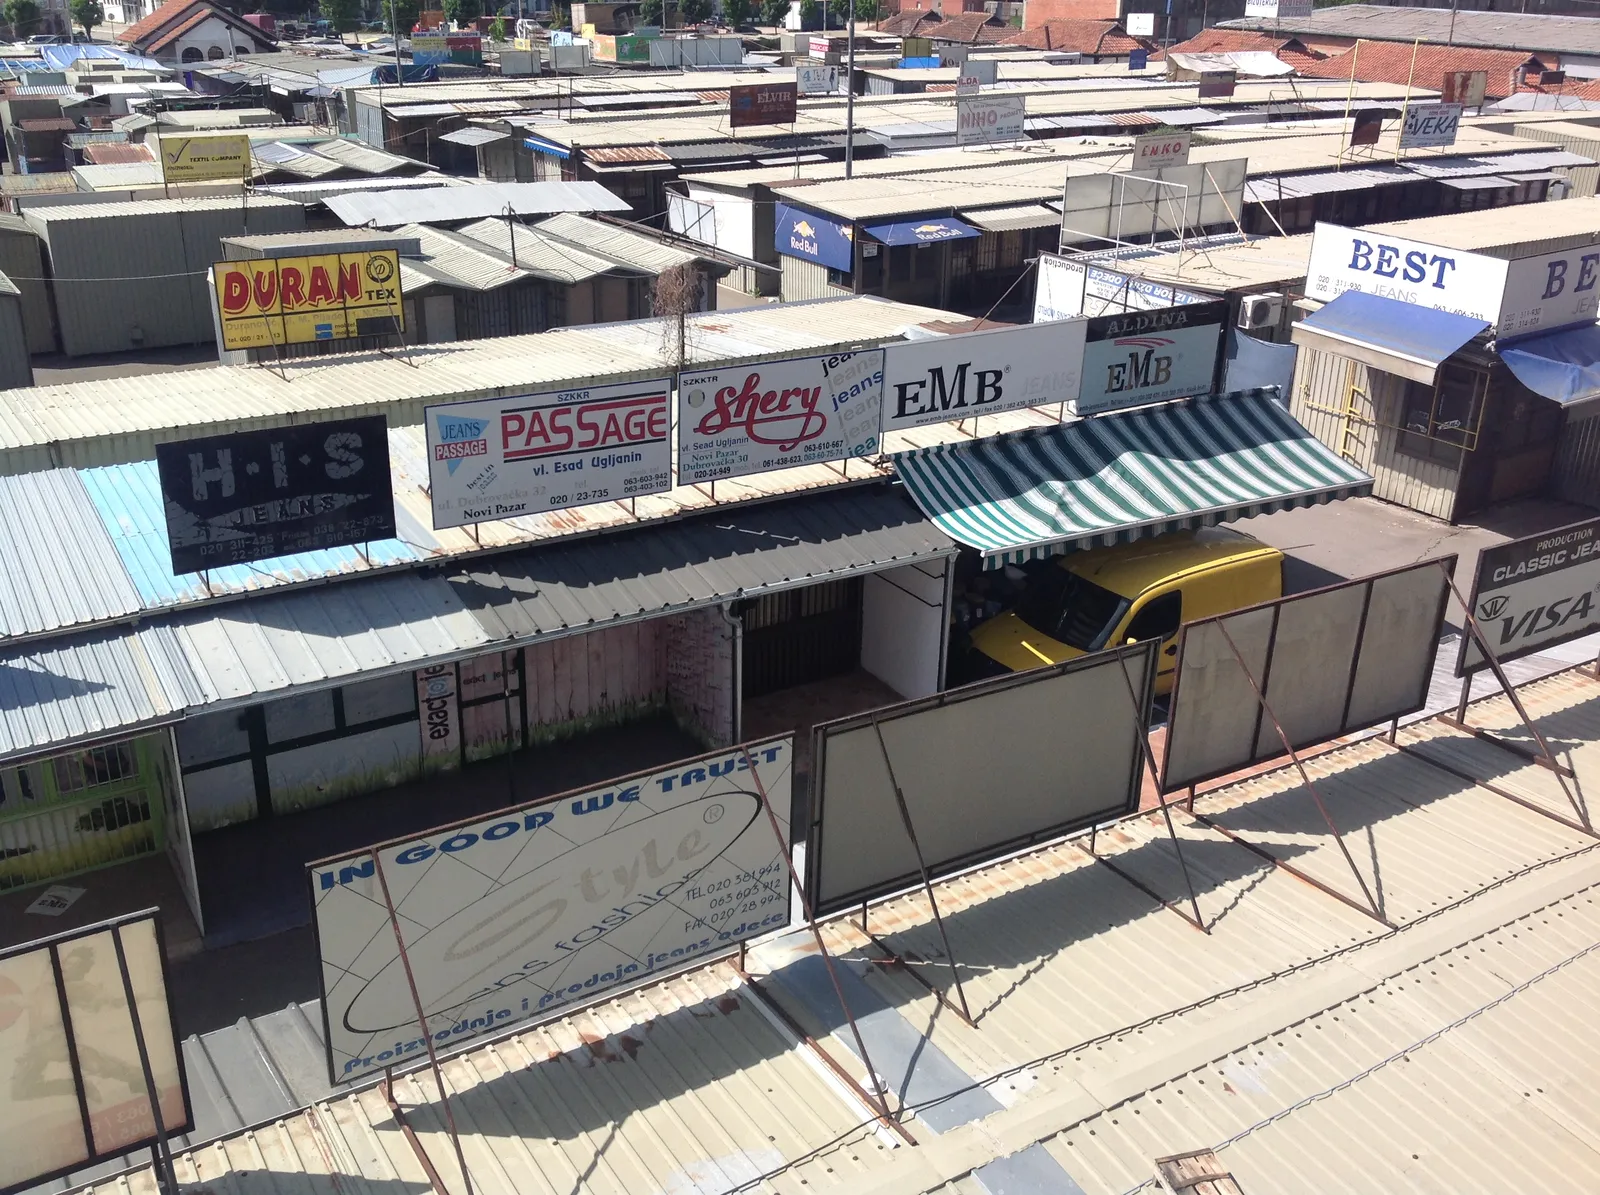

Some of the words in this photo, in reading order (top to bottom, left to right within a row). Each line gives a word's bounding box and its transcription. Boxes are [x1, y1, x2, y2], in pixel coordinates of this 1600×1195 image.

[1412, 115, 1459, 136] VEKA
[790, 236, 804, 251] Red
[804, 239, 818, 256] Bull
[915, 232, 943, 241] Red
[1348, 238, 1457, 289] BEST
[222, 261, 363, 315] DURAN
[1541, 253, 1600, 301] BE
[365, 288, 398, 301] TEX
[1370, 283, 1418, 304] JEANS
[1106, 311, 1189, 335] ALDINA
[683, 375, 718, 387] SZKKTR
[1105, 349, 1173, 394] EMB
[557, 391, 590, 402] SZKKR
[831, 371, 883, 413] jeans
[891, 361, 1004, 420] EMB
[693, 372, 827, 453] Shery
[441, 421, 481, 442] JEANS
[501, 396, 667, 459] PASSAGE
[435, 439, 487, 461] PASSAGE
[693, 440, 714, 451] Sead
[716, 436, 749, 448] Ugljanin
[533, 464, 549, 477] vl.
[554, 458, 583, 474] Esad
[591, 451, 642, 470] Ugljanin
[683, 457, 735, 472] Dubrovačka
[736, 454, 749, 463] 30
[692, 451, 713, 463] Novi
[715, 449, 740, 459] Pazar
[466, 472, 485, 491] best
[624, 472, 668, 486] 063-603-942
[694, 466, 731, 479] 020-24-949
[549, 494, 568, 505] 020
[576, 488, 609, 502] 23-735
[624, 480, 668, 493] 063-403-102
[463, 505, 492, 520] Novi
[496, 501, 527, 516] Pazar
[1536, 529, 1595, 553] PRODUCTION
[1493, 550, 1568, 583] CLASSIC
[1500, 591, 1596, 646] VISA
[420, 692, 455, 740] exact
[319, 859, 375, 891] IN
[395, 809, 555, 866] GOOD
[571, 784, 641, 819] WE
[655, 745, 783, 795] TRUST
[707, 878, 732, 895] 020
[734, 869, 756, 886] 381
[709, 892, 733, 910] 063
[735, 885, 760, 901] 603
[710, 907, 735, 924] 020
[741, 900, 757, 914] 28
[343, 1010, 511, 1073] Proizvodnja
[520, 997, 530, 1013] i
[538, 962, 639, 1009] prodaja
[646, 936, 711, 970] jeans
[718, 913, 785, 942] odeće
